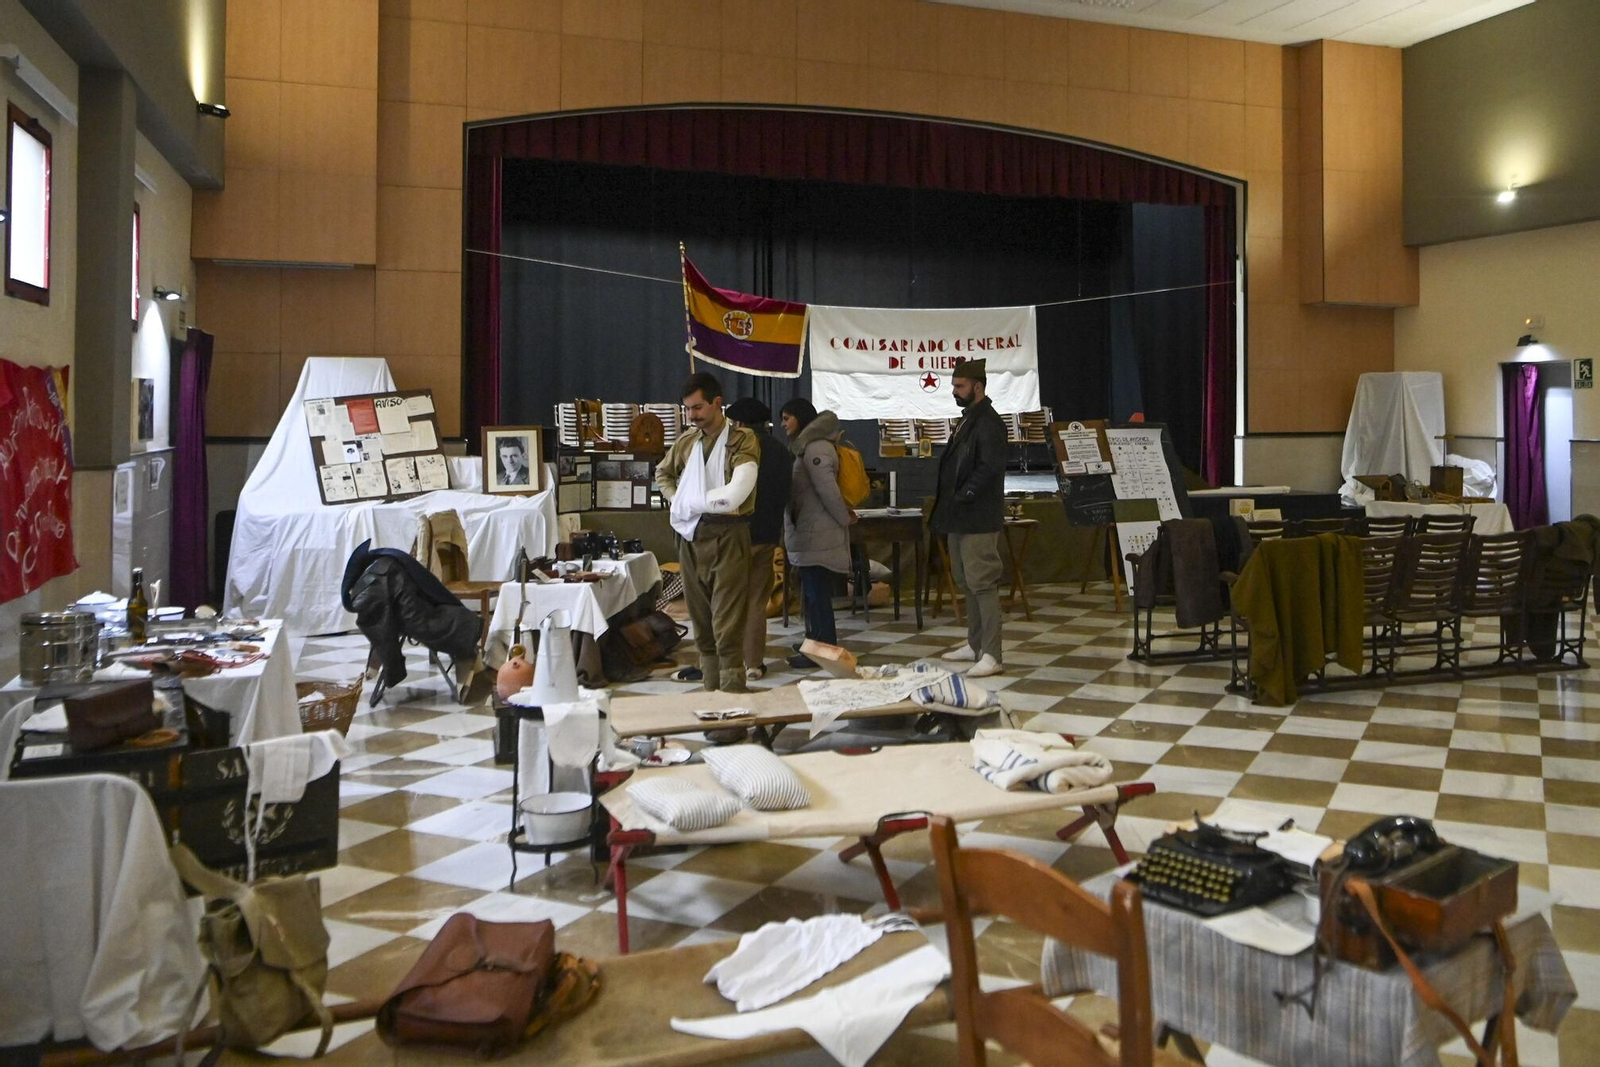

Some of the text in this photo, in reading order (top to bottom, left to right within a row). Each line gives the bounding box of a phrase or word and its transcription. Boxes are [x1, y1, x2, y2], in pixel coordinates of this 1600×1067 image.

[830, 334, 1022, 352] COMISARIADO GENERAL
[888, 356, 975, 369] DE GUER
[375, 398, 403, 408] AVISO
